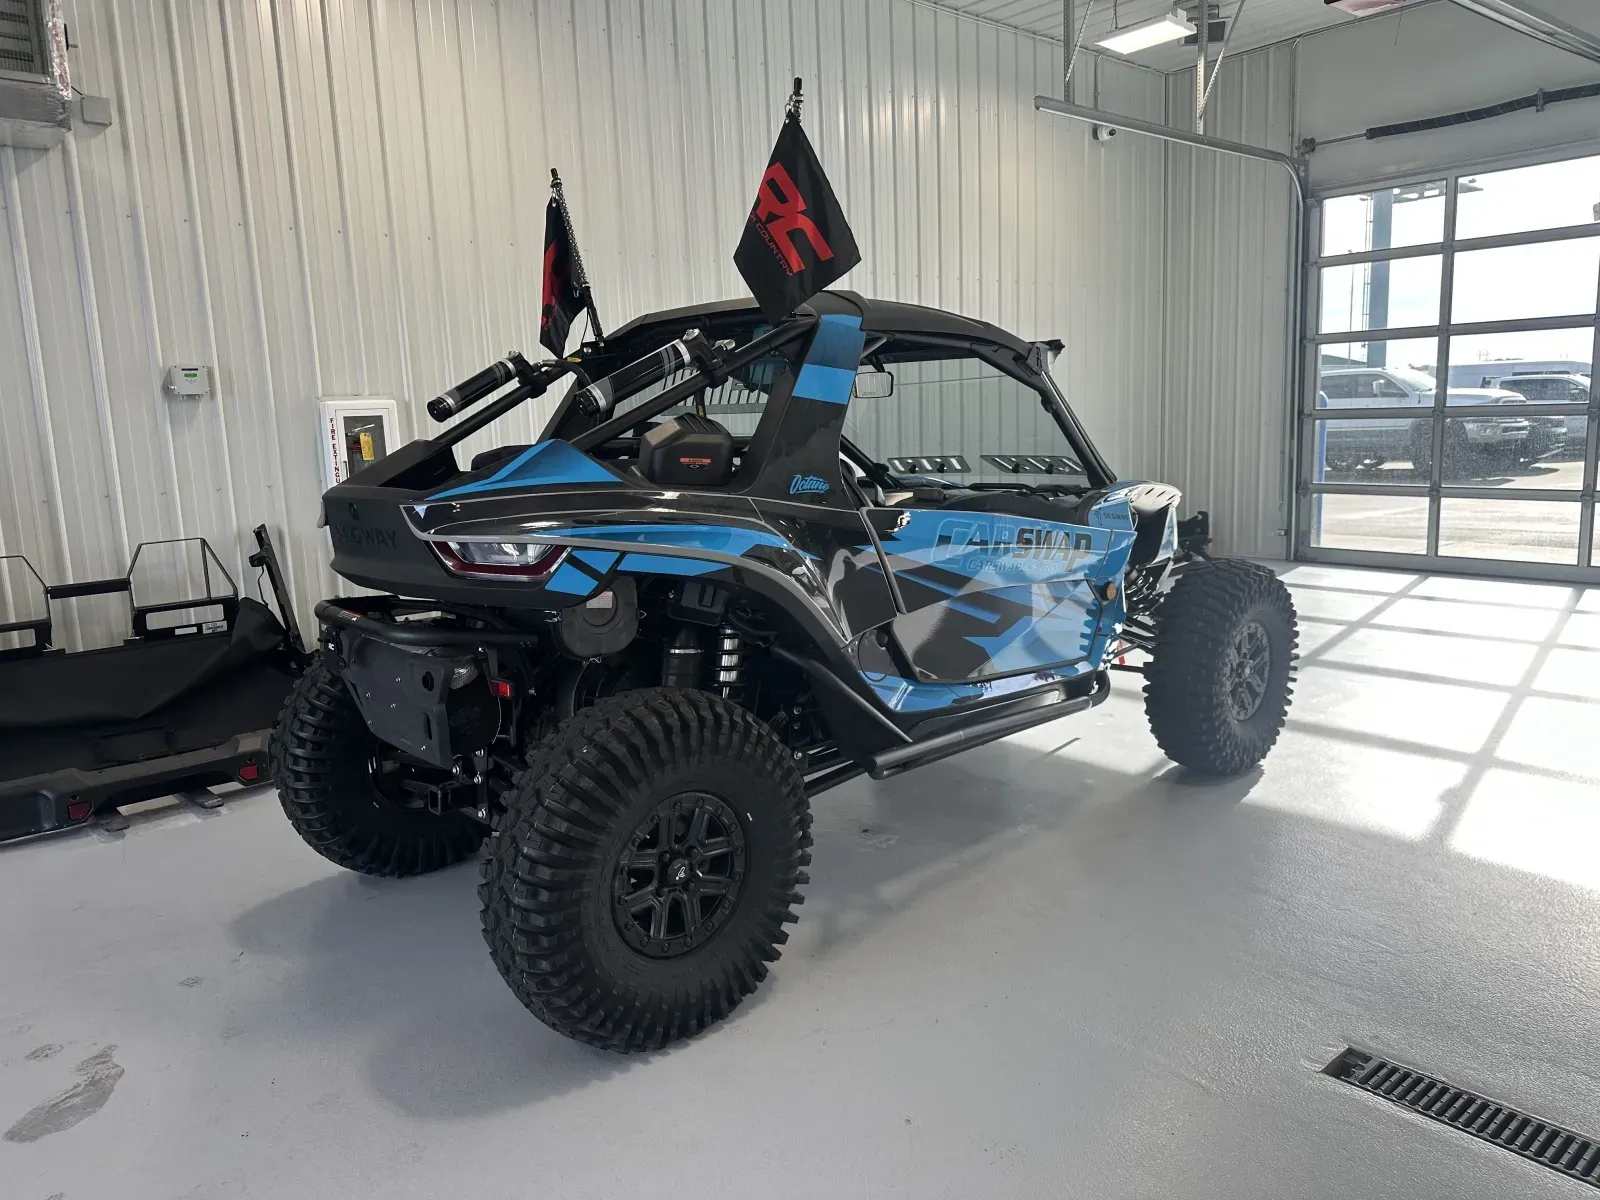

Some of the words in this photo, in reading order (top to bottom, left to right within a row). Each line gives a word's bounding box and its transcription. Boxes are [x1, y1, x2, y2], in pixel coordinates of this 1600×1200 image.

[756, 222, 793, 277] COUNTRY
[329, 417, 337, 441] FIRE
[332, 443, 341, 484] EXTINGU
[789, 474, 829, 495] Octane
[931, 517, 1093, 573] CARSWAP
